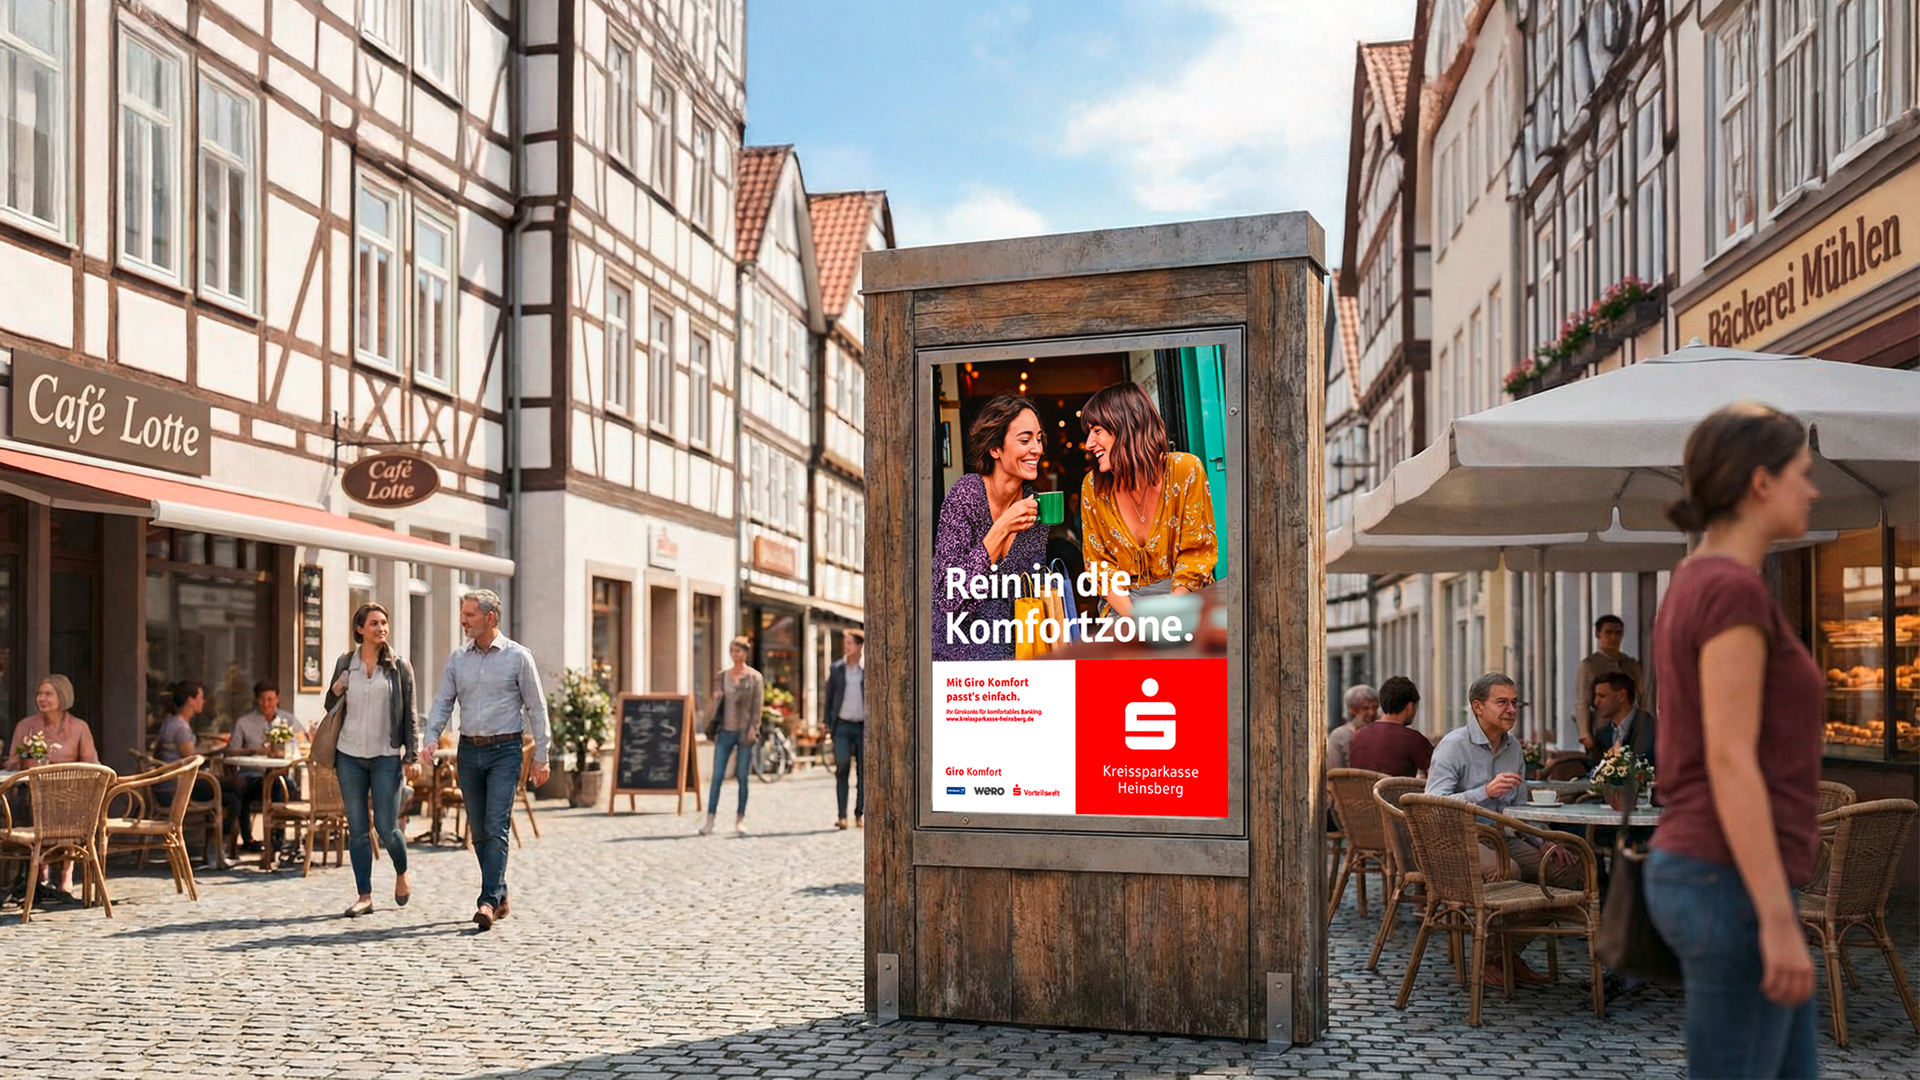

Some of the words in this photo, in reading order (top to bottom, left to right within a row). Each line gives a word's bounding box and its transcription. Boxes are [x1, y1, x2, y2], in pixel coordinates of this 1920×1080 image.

[1708, 262, 1796, 347] Bäckerei
[1801, 214, 1902, 307] Mühlen
[28, 373, 106, 444] Café
[119, 395, 200, 457] Lotte
[368, 459, 413, 483] Café
[366, 481, 415, 500] Lotte
[946, 563, 1021, 600] Rein
[1033, 562, 1064, 598] in
[1076, 561, 1131, 597] die
[946, 608, 1194, 645] Komfortzone.
[947, 678, 962, 687] Mit
[965, 678, 985, 687] Giro
[988, 677, 1028, 687] Komfort
[982, 691, 1020, 701] einfach.
[946, 767, 964, 776] Giro
[967, 767, 1001, 776] Komfort
[1104, 765, 1198, 780] Kreissparkasse
[1119, 782, 1183, 797] Heinsberg
